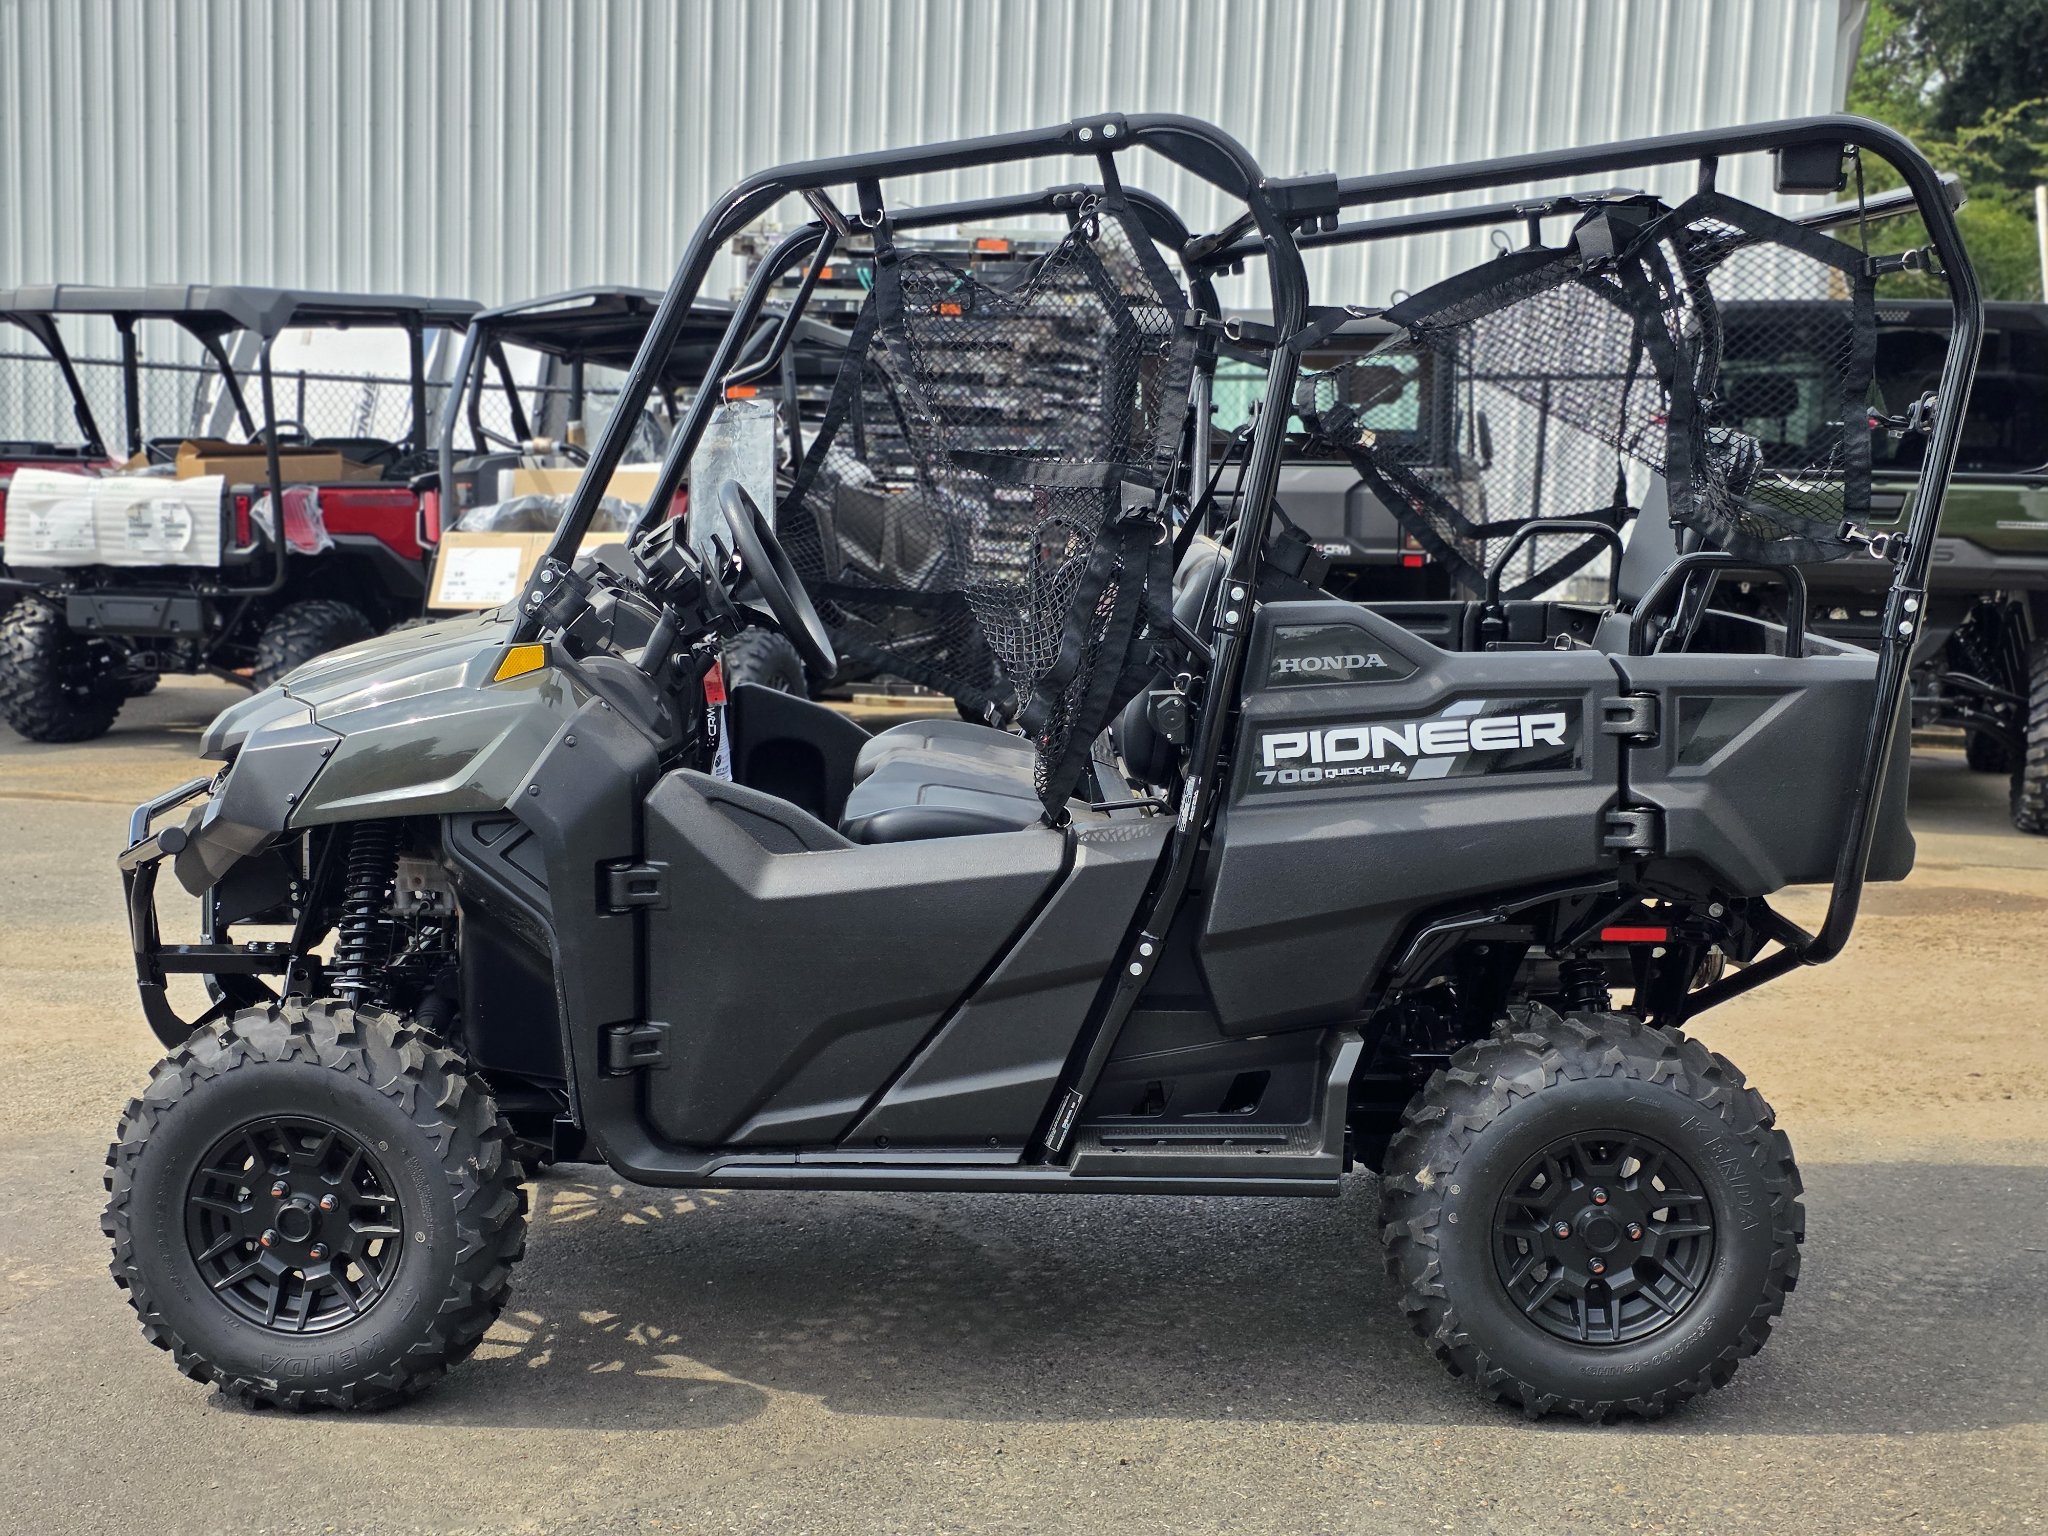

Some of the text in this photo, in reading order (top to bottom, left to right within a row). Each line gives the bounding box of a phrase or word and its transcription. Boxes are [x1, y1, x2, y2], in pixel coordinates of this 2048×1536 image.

[1323, 543, 1351, 556] CRM
[1277, 653, 1388, 673] HONDA
[706, 706, 717, 737] CRM
[1262, 712, 1567, 767] PIONEER
[1255, 767, 1323, 785] 700
[1680, 1115, 1760, 1230] KENDA
[260, 1330, 387, 1378] KENDA
